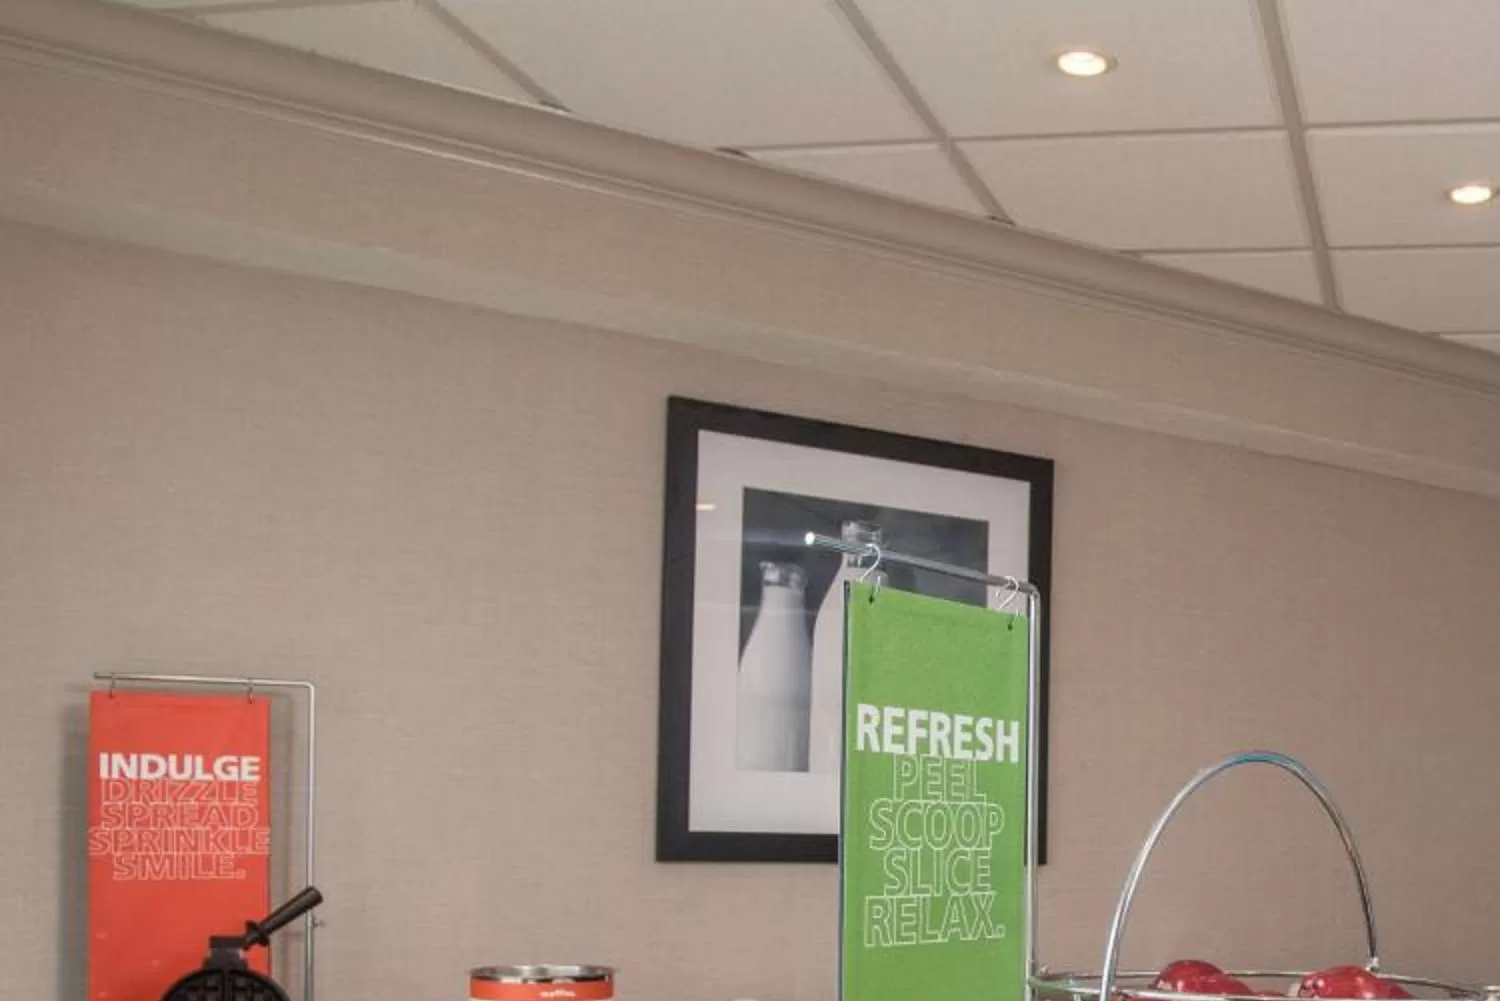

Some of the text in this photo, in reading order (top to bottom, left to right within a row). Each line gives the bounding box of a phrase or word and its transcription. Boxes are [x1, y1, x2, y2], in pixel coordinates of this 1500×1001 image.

[857, 703, 1020, 764] REFRESH
[99, 751, 262, 782] INDULGE
[893, 753, 987, 803] PEEL
[101, 778, 259, 807] DRIZZLE
[101, 800, 260, 831] SPREAD
[869, 798, 1005, 851] SCOOP
[87, 825, 272, 857] SPRINKLE
[112, 851, 248, 881] SMILE.
[884, 848, 992, 897] SLICE
[864, 891, 1006, 948] RELAX.
